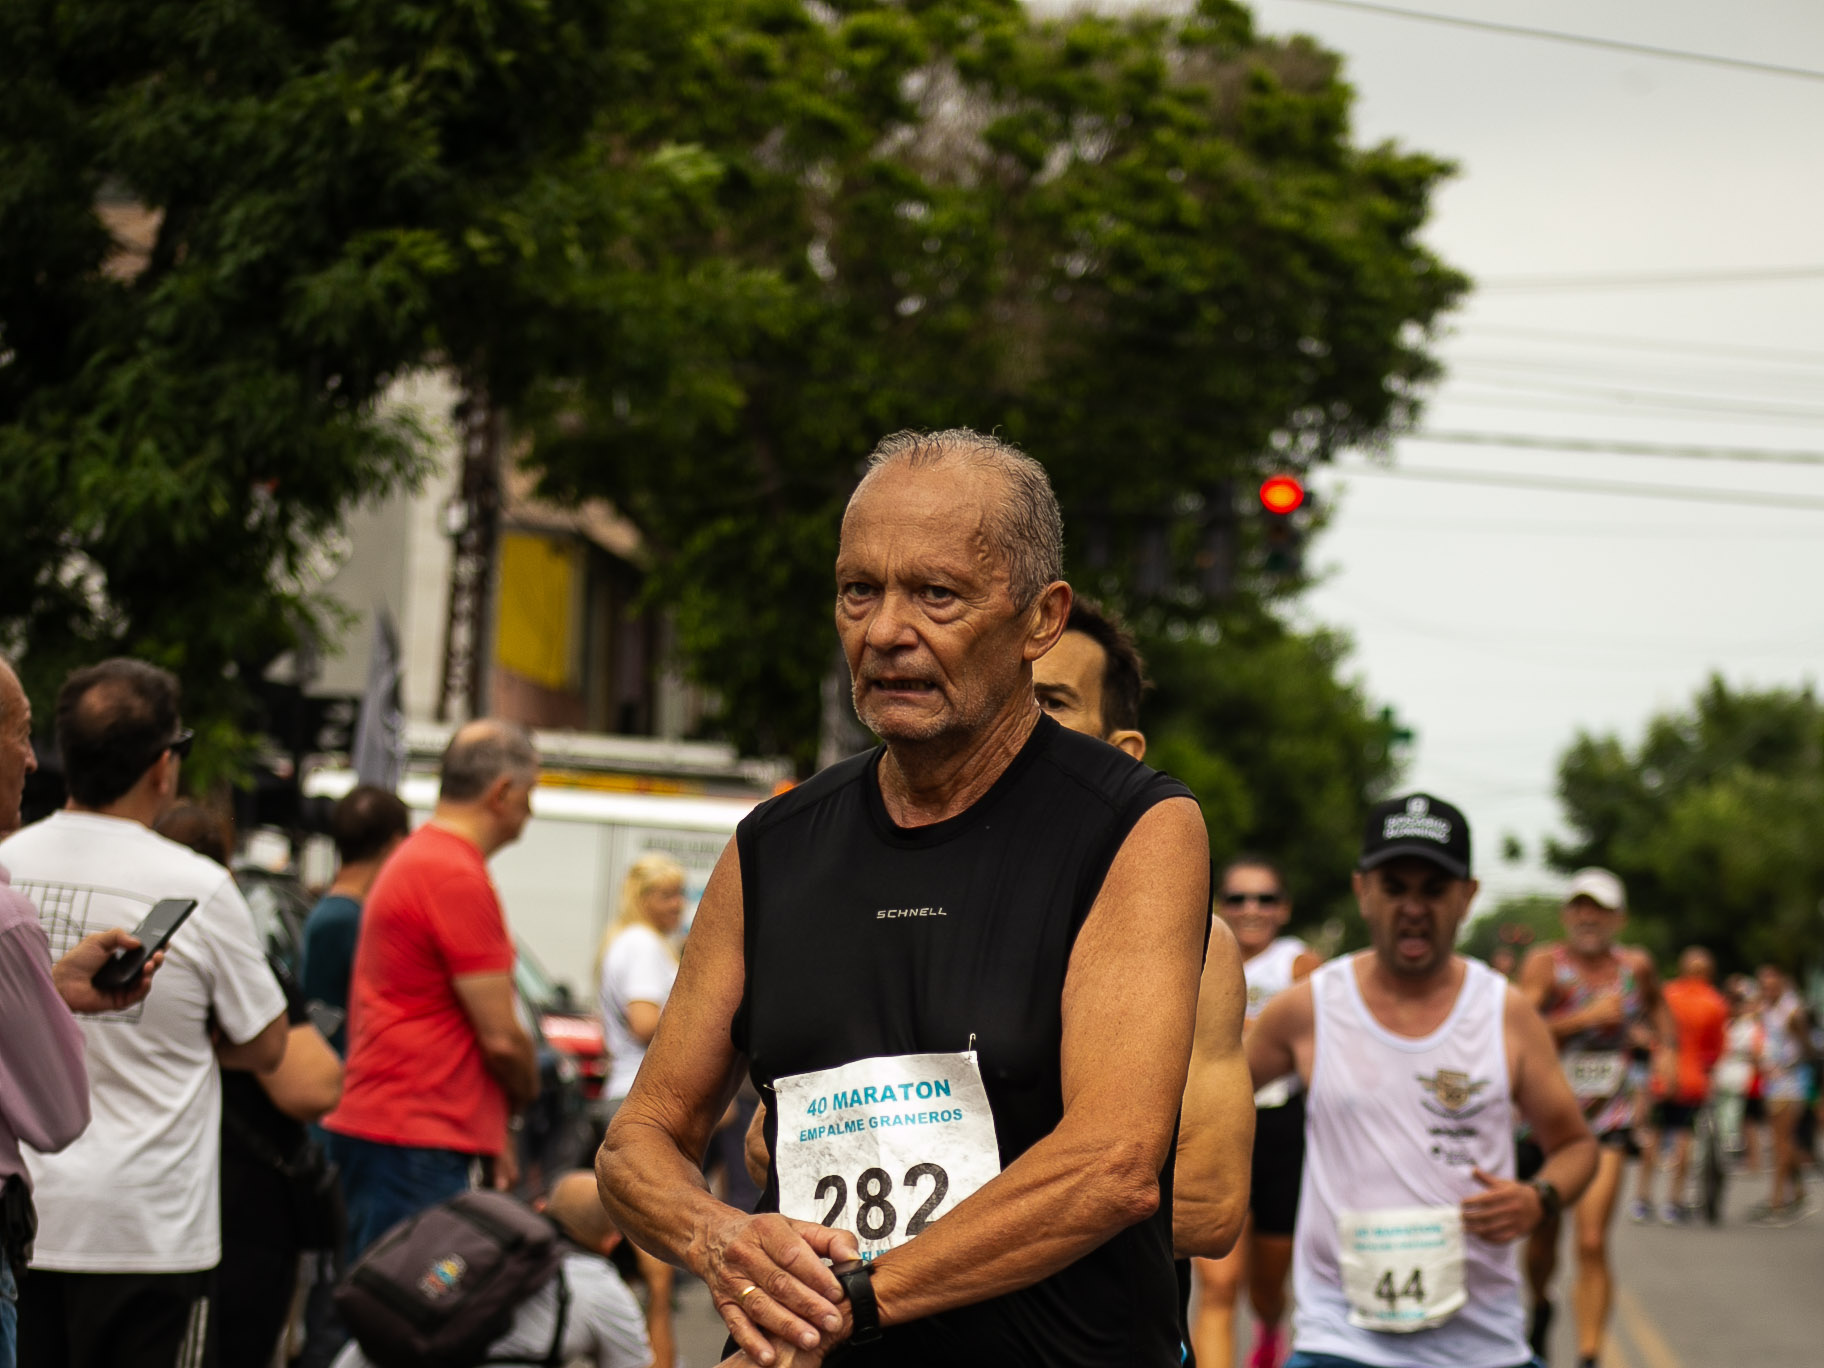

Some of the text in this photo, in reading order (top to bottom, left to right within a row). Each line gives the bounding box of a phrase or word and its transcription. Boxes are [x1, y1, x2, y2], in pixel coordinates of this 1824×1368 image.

[876, 907, 947, 919] SCHNELL
[806, 1078, 951, 1117] 40 MARATON
[800, 1108, 963, 1142] EMPALME GRANEROS
[814, 1162, 949, 1240] 282
[1375, 1267, 1425, 1309] 44
